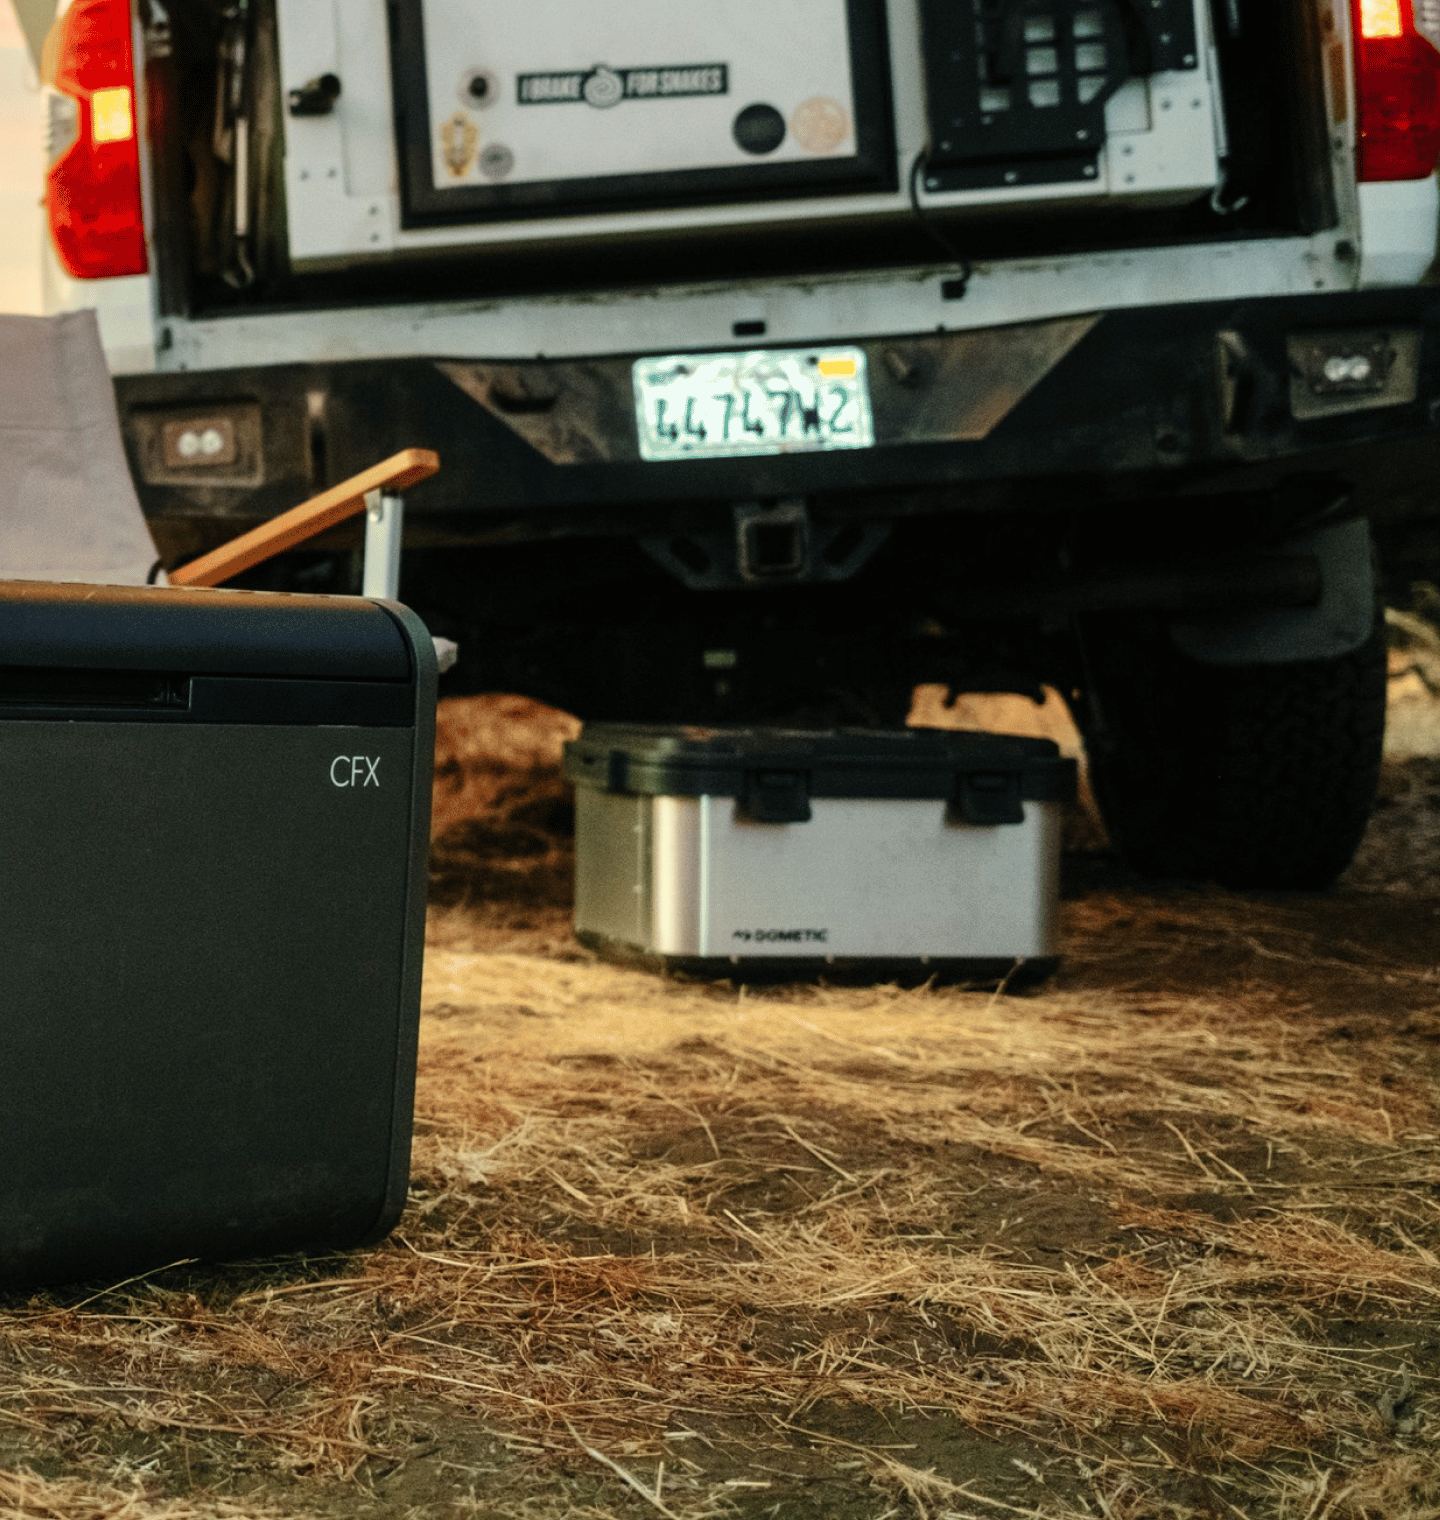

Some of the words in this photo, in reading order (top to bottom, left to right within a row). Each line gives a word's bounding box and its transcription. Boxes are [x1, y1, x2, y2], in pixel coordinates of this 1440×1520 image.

[627, 72, 658, 96] FOR
[661, 68, 722, 94] SNAKES
[330, 755, 381, 787] CFX
[755, 928, 828, 944] DOMETIC
